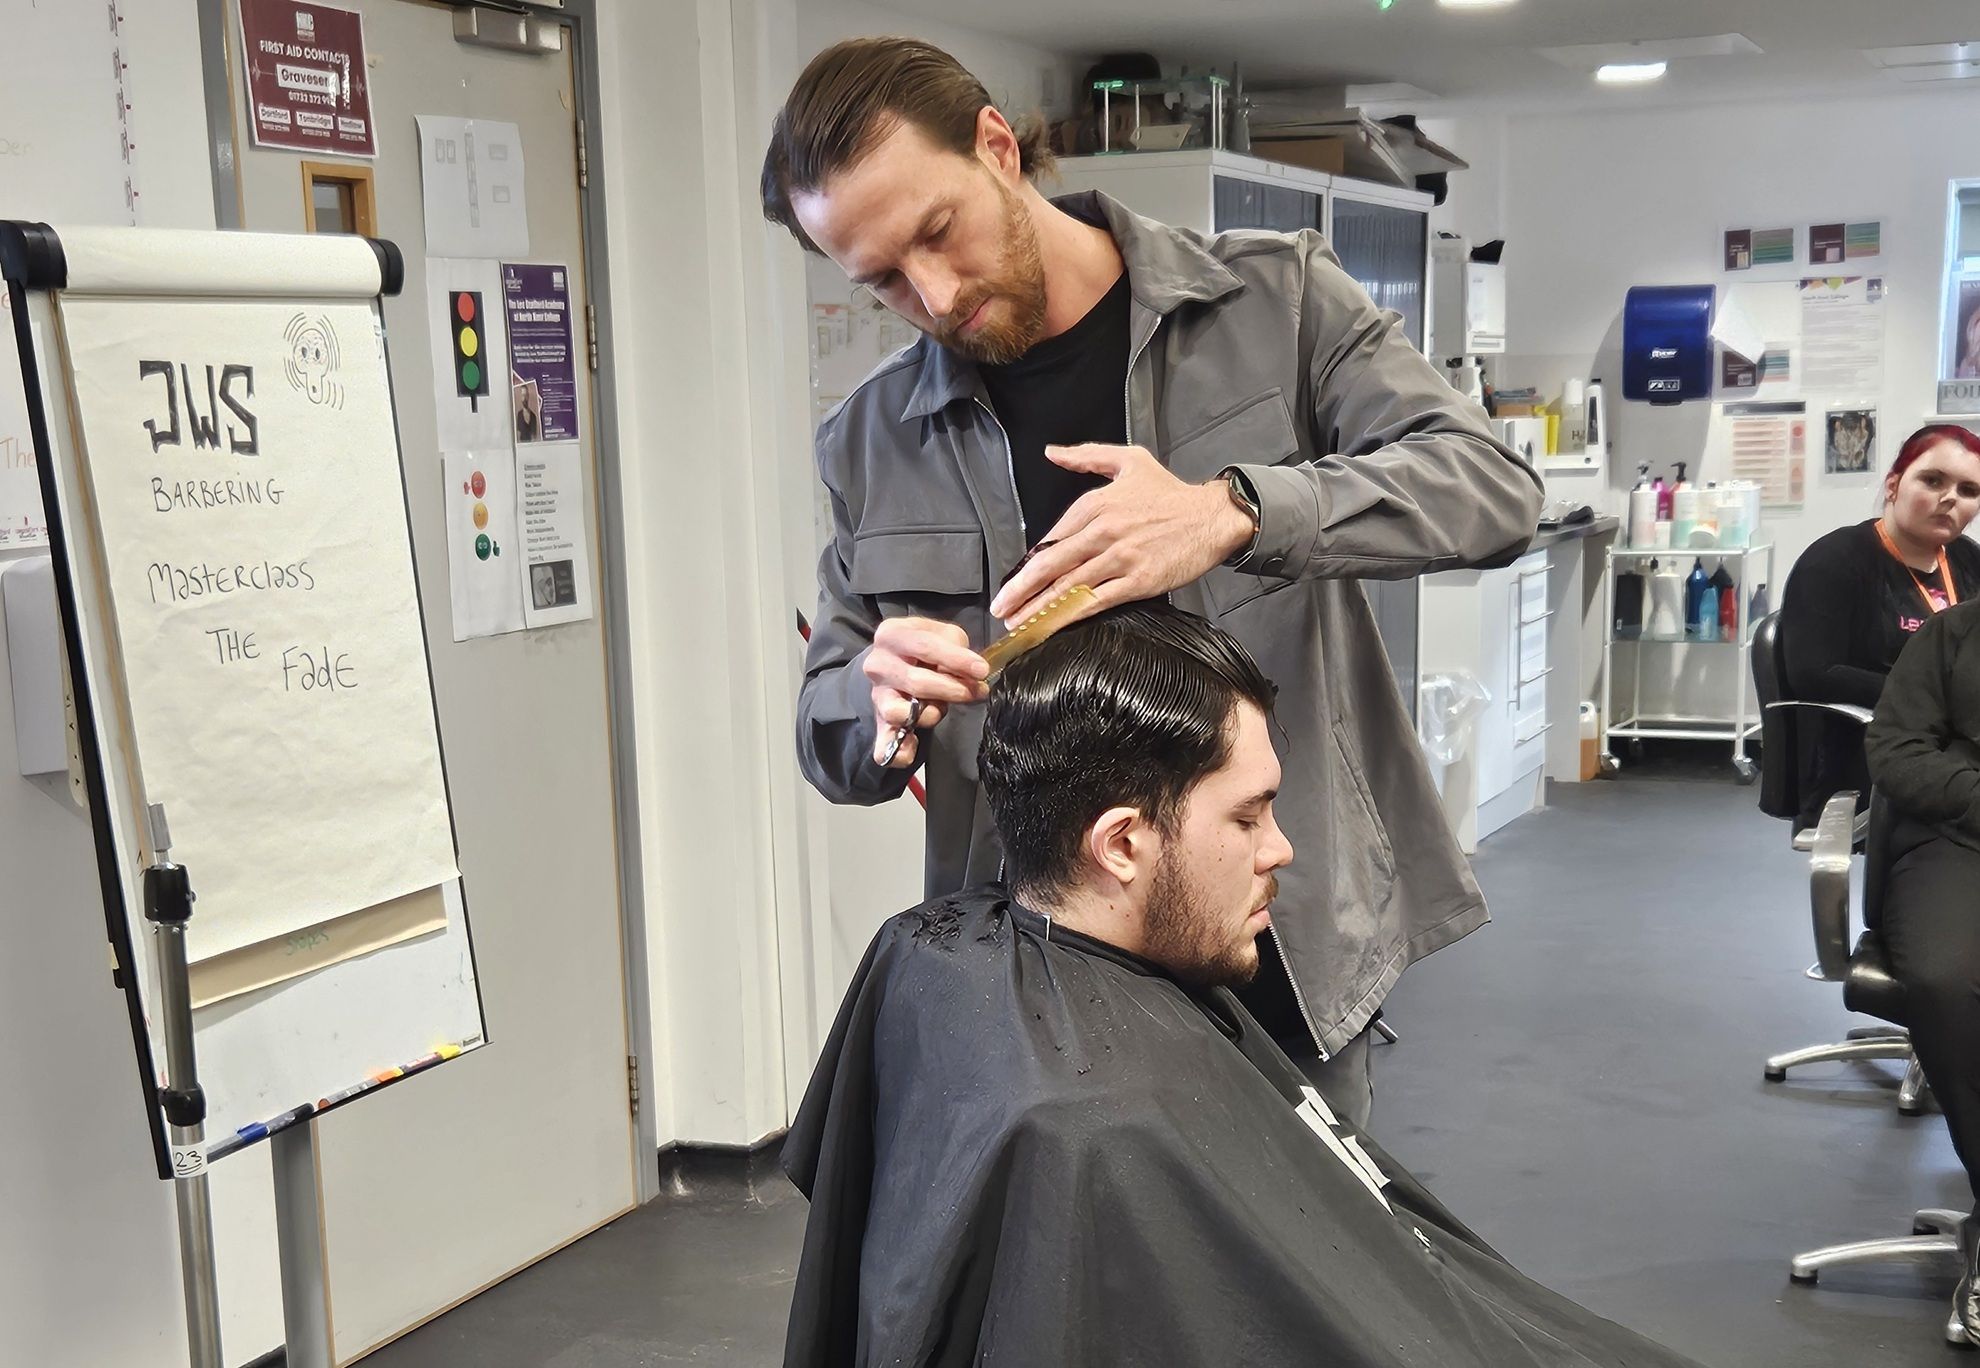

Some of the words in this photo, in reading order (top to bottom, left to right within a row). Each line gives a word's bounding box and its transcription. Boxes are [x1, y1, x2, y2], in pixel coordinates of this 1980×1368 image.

[260, 40, 284, 55] FIRST
[286, 45, 302, 58] AID
[304, 48, 350, 65] CONTACTS
[139, 360, 259, 456] JWS
[151, 473, 284, 513] BARBERING
[147, 561, 315, 603] Masterclass
[206, 627, 261, 664] THE
[175, 1150, 202, 1168] 23
